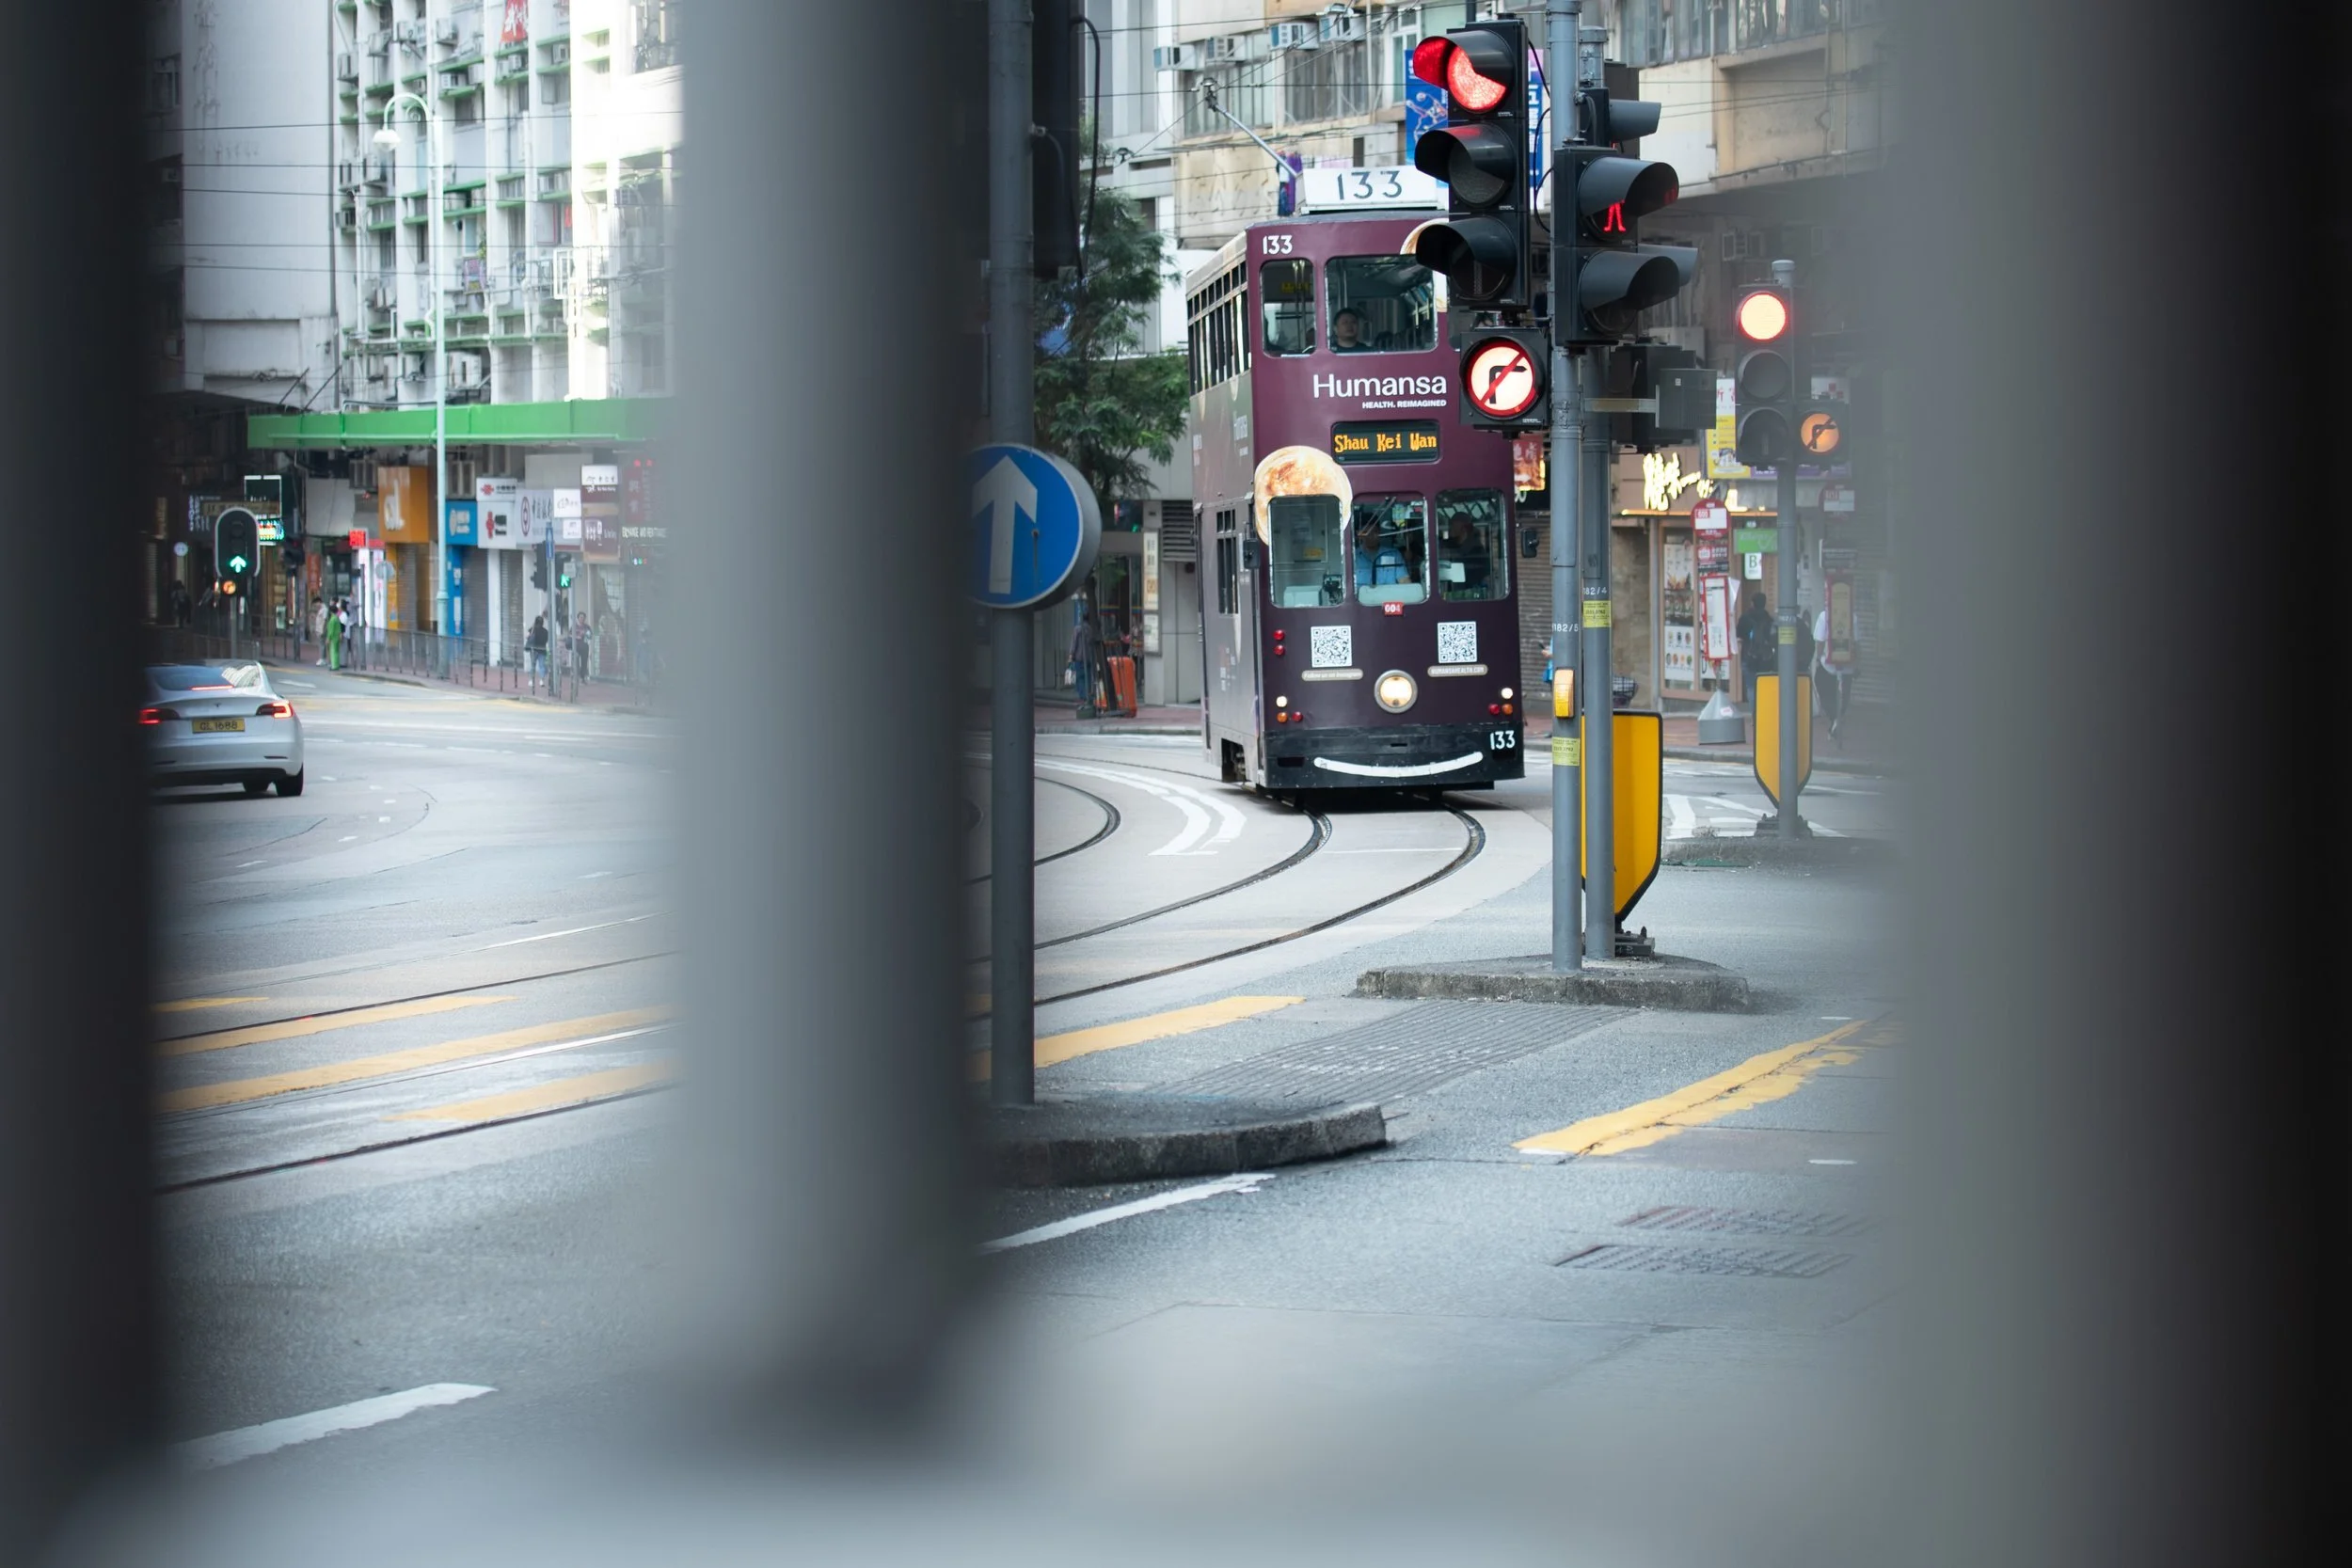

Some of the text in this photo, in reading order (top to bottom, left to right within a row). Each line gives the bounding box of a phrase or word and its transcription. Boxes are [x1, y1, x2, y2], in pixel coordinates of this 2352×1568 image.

[1336, 170, 1403, 200] 133
[1262, 234, 1293, 255] 133
[1312, 373, 1447, 398] Humansa
[1361, 400, 1447, 409] HEALTH. REIMAGINED
[1334, 432, 1438, 453] Shau Kei Wan
[1489, 730, 1516, 751] 133
